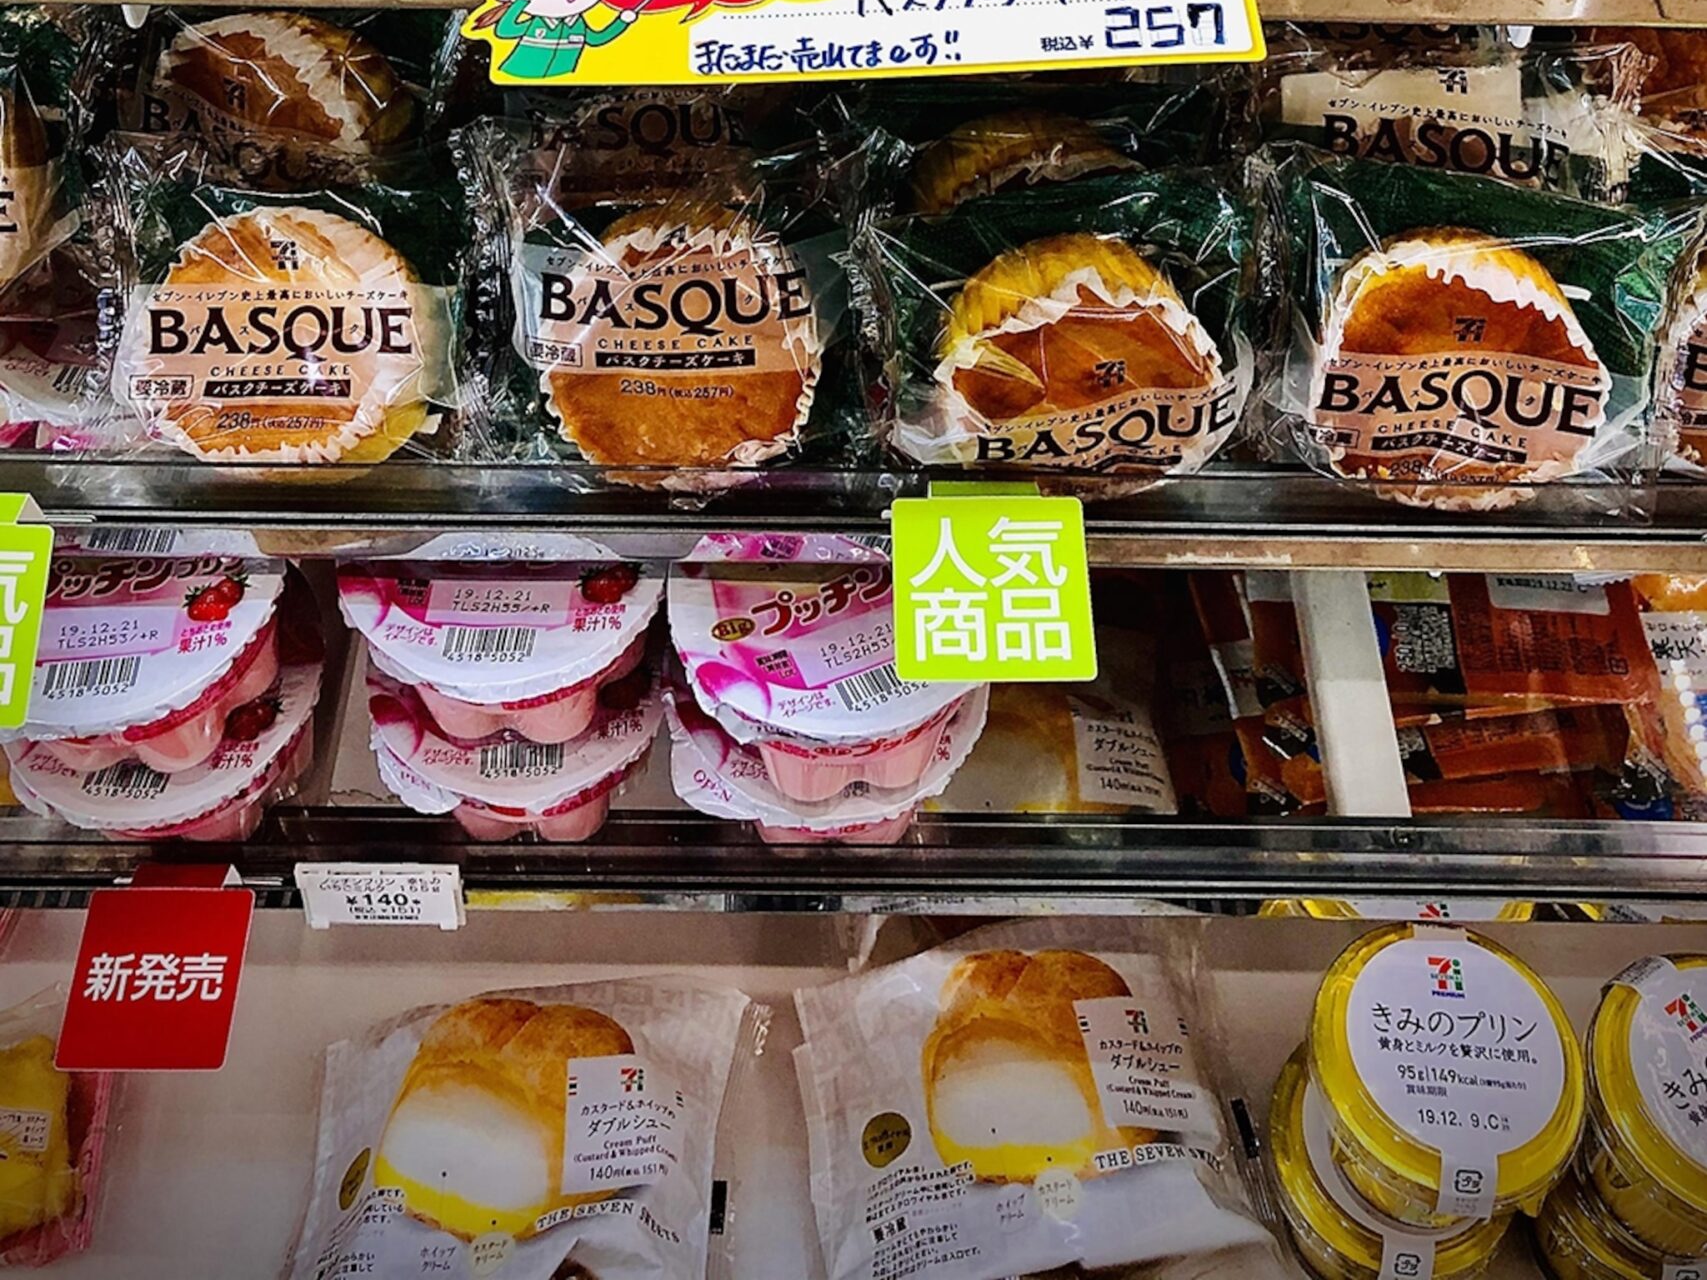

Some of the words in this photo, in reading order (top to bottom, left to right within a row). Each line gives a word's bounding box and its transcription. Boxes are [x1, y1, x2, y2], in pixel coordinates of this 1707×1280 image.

[1105, 1, 1226, 49] 257
[540, 270, 813, 337] BASQUE
[148, 305, 414, 363] BASQUE
[597, 335, 681, 350] CHEESE
[696, 334, 754, 349] CAKE
[210, 364, 285, 377] CHEESE
[604, 351, 748, 367] バスクチーズケーキ
[1315, 367, 1605, 437] BASQUE
[976, 386, 1238, 461] BASQUE
[1377, 419, 1454, 435] CHEESE
[1470, 425, 1528, 448] CAKE
[909, 517, 1069, 588] 人気
[454, 588, 532, 602] 19.12.21
[60, 620, 139, 636] 19.12.21
[571, 614, 623, 633] 果汁1%
[716, 621, 751, 637] Big
[910, 587, 1073, 663] 商品
[177, 632, 228, 655] 果汁1%
[820, 623, 892, 657] 19.12.21
[489, 652, 526, 664] 5052
[83, 952, 229, 1003] 新発売
[1371, 1003, 1538, 1044] きみのプリン
[1110, 1054, 1181, 1073] ダブルシュー
[588, 1115, 672, 1138] ダブルシュー
[603, 1139, 633, 1150] Cream
[636, 1135, 657, 1146] Puff
[1094, 1149, 1132, 1170] THE
[1135, 1142, 1187, 1163] SEVEN
[537, 1208, 571, 1229] THE
[576, 1202, 635, 1216] SEVEN
[419, 1246, 457, 1259] ホイップ
